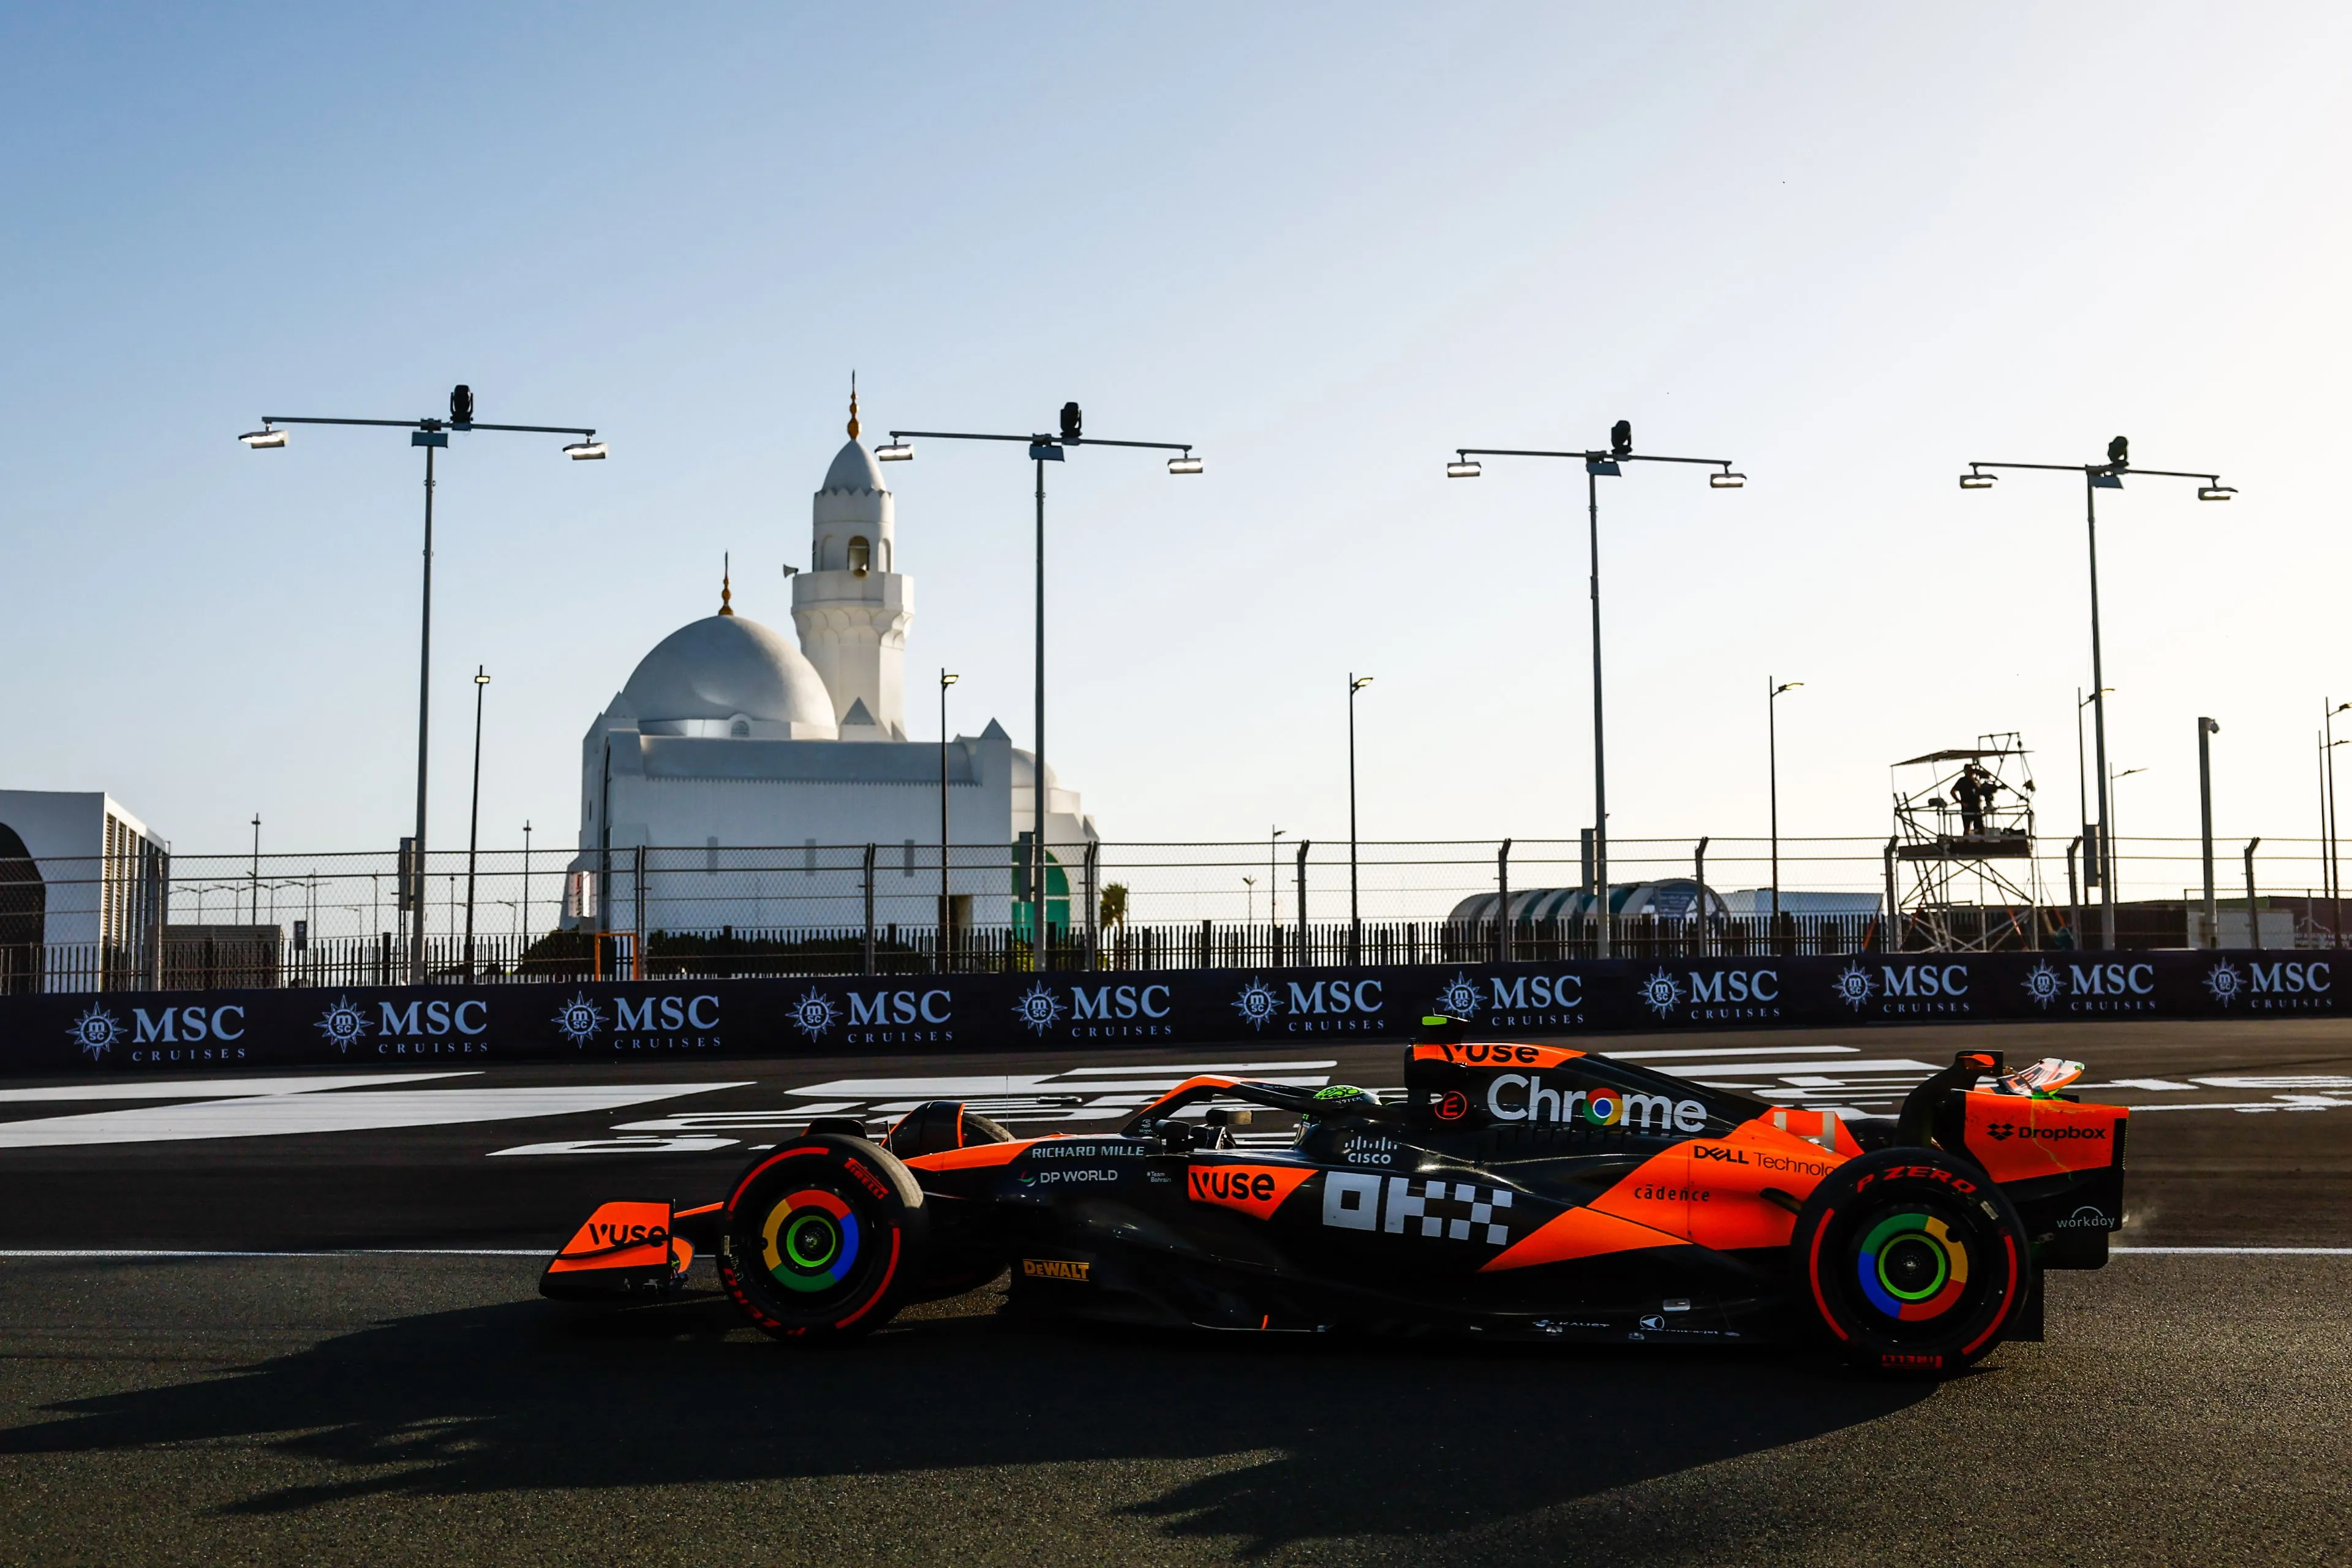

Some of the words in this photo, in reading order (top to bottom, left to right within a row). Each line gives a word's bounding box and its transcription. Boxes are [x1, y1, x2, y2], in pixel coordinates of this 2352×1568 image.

[1882, 965, 1967, 996] MSC
[2070, 964, 2153, 994] MSC
[2250, 963, 2330, 992] MSC
[1491, 976, 1581, 1009] MSC
[1689, 970, 1777, 1003] MSC
[1071, 986, 1170, 1019] MSC
[1287, 980, 1382, 1014] MSC
[2071, 1001, 2155, 1010] CRUISES
[2252, 999, 2331, 1008] CRUISES
[614, 995, 718, 1031] MSC
[847, 990, 951, 1025] MSC
[1691, 1009, 1779, 1019] CRUISES
[1883, 1003, 1969, 1012] CRUISES
[132, 1006, 244, 1042] MSC
[379, 1001, 486, 1035] MSC
[1289, 1020, 1383, 1031] CRUISES
[1492, 1015, 1583, 1026] CRUISES
[848, 1032, 952, 1042] CRUISES
[1072, 1026, 1170, 1037] CRUISES
[379, 1043, 487, 1053] CRUISES
[614, 1038, 720, 1049] CRUISES
[132, 1049, 244, 1061] CRUISES
[1487, 1074, 1707, 1133] Chrome
[2018, 1126, 2107, 1141] Dropbox
[1031, 1146, 1096, 1158] RICHARD
[1101, 1145, 1145, 1157] MILLE
[1348, 1153, 1391, 1164] CISCO
[1694, 1145, 1749, 1165] DELL
[844, 1157, 890, 1201] PIRELLI
[1040, 1172, 1060, 1183] DP
[1061, 1169, 1118, 1182] WORLD
[1856, 1173, 1876, 1194] P
[1883, 1165, 1978, 1194] ZERO
[1322, 1170, 1512, 1245] OKX
[2057, 1215, 2115, 1228] workday
